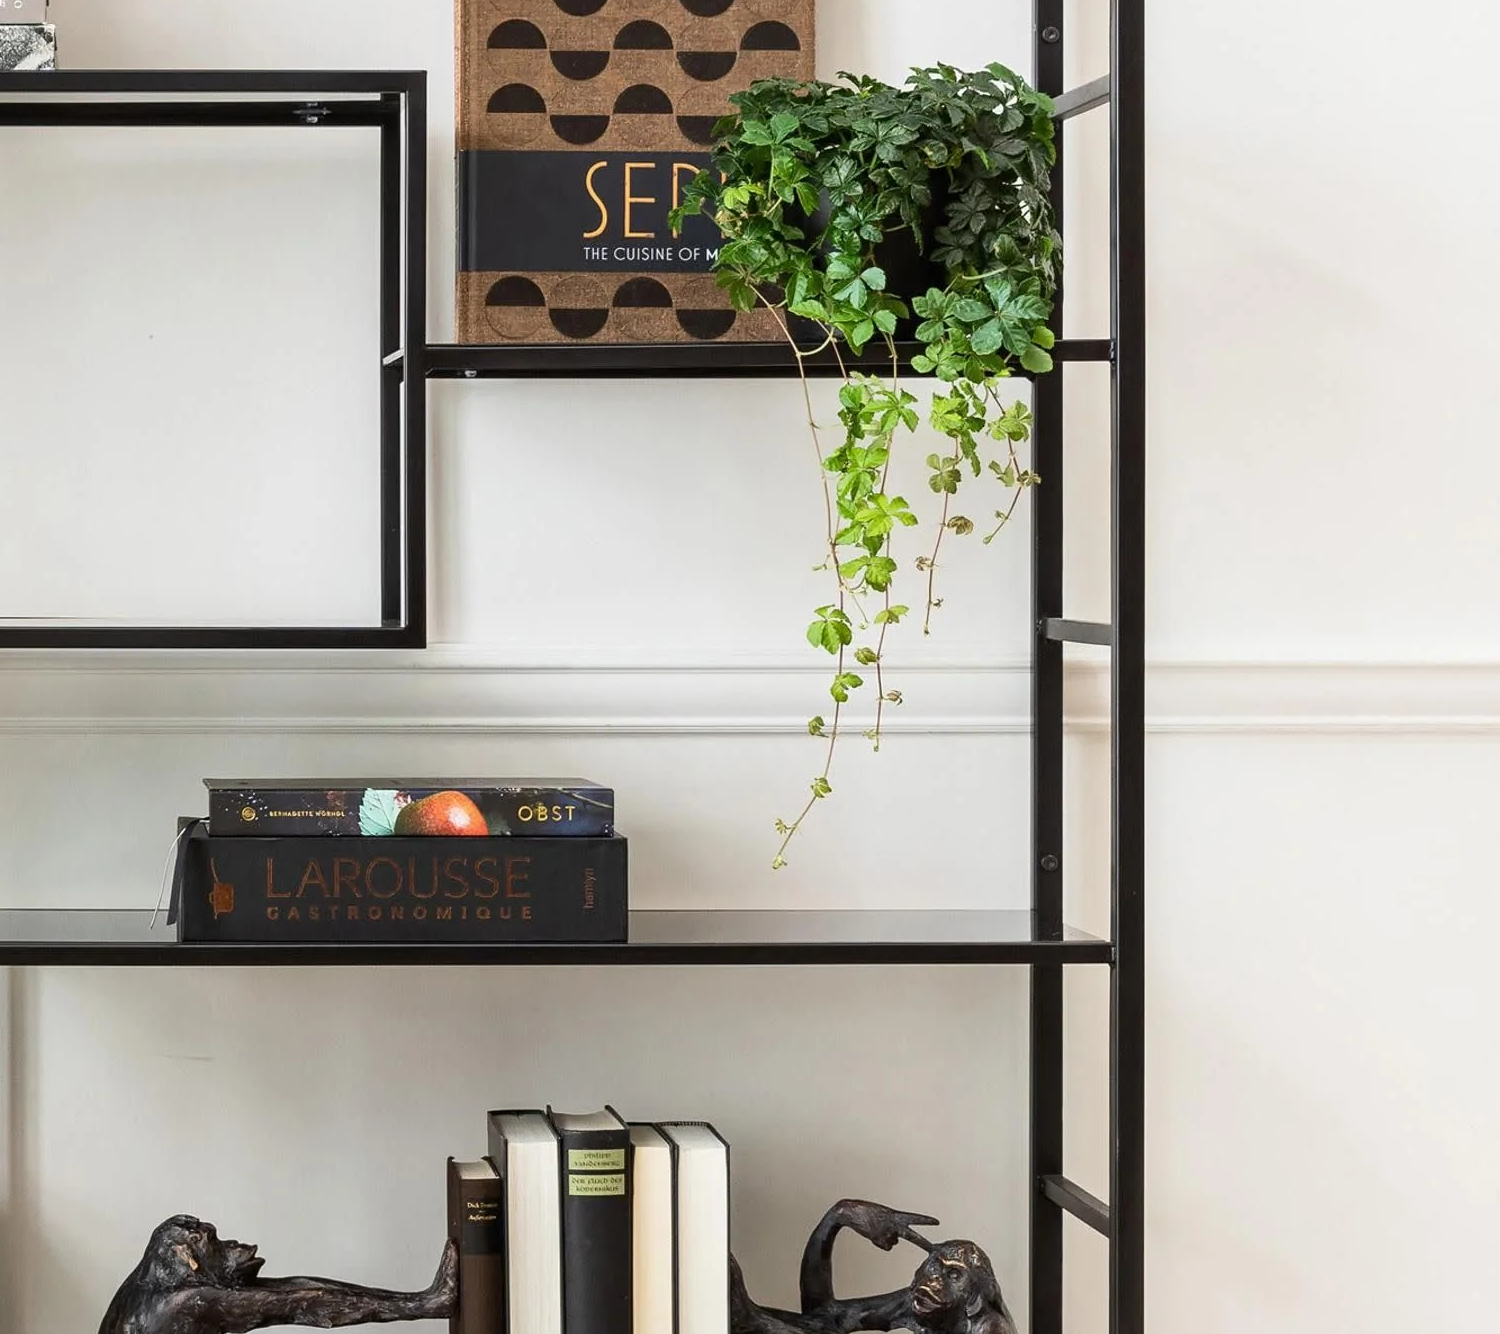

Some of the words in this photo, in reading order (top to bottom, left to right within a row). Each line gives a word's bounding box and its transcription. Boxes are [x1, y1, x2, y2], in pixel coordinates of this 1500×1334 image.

[583, 247, 608, 261] THE
[613, 247, 673, 261] CUISINE
[678, 247, 701, 261] OF
[517, 805, 577, 822] OBST
[265, 856, 533, 899] LAROUSSE
[265, 905, 533, 920] GASTRONOMIQUE
